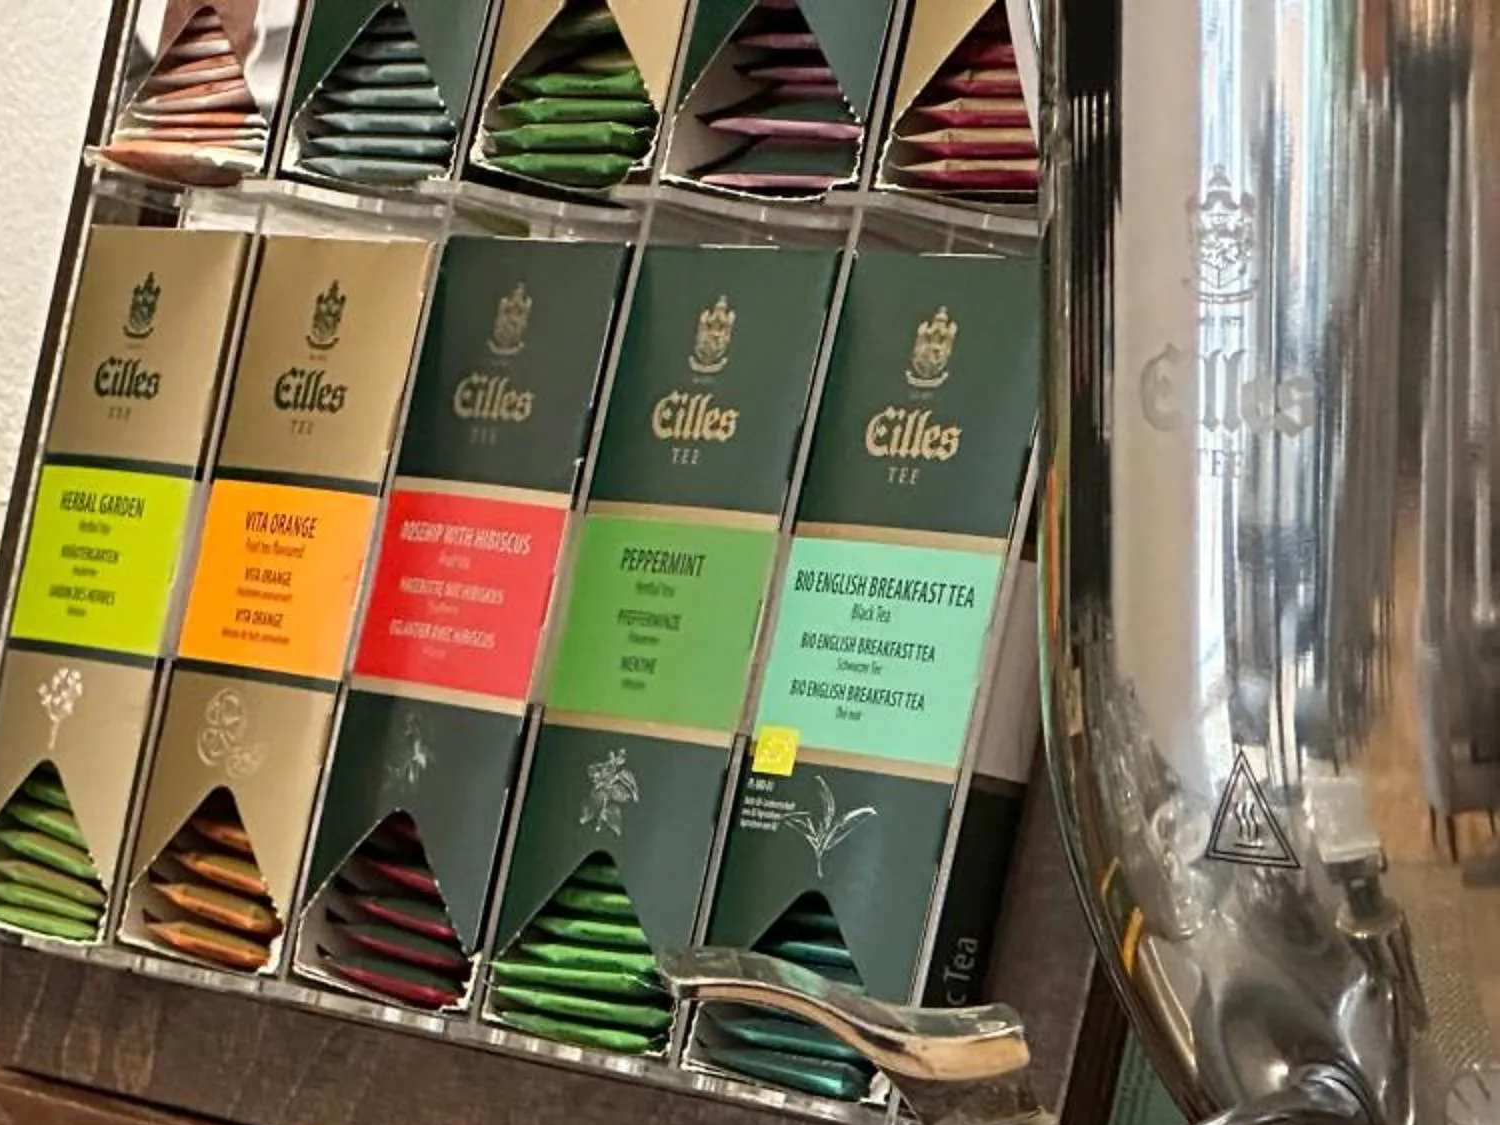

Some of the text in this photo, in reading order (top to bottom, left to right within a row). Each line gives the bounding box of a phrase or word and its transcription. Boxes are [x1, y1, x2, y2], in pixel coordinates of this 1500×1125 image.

[94, 356, 162, 400] Eilles
[274, 367, 349, 414] Eilles
[454, 372, 536, 423] Eilles
[652, 390, 740, 442] Eilles
[866, 406, 963, 461] Eilles
[672, 447, 701, 465] TEE
[888, 467, 920, 485] TEE
[60, 490, 146, 518] HERBAL GARDEN
[245, 511, 318, 539] VITA ORANGE
[474, 527, 532, 555] HIBISCUS
[620, 547, 707, 577] PEPPERMINT
[795, 569, 976, 608] BIO ENGLISH BREAKFAST TEA
[851, 603, 891, 623] Black Tea
[801, 631, 936, 663] BIO ENGLISH BREAKFAST TEA
[790, 678, 926, 712] BIO ENGLISH BREAKFAST TEA
[943, 937, 979, 983] Tea
